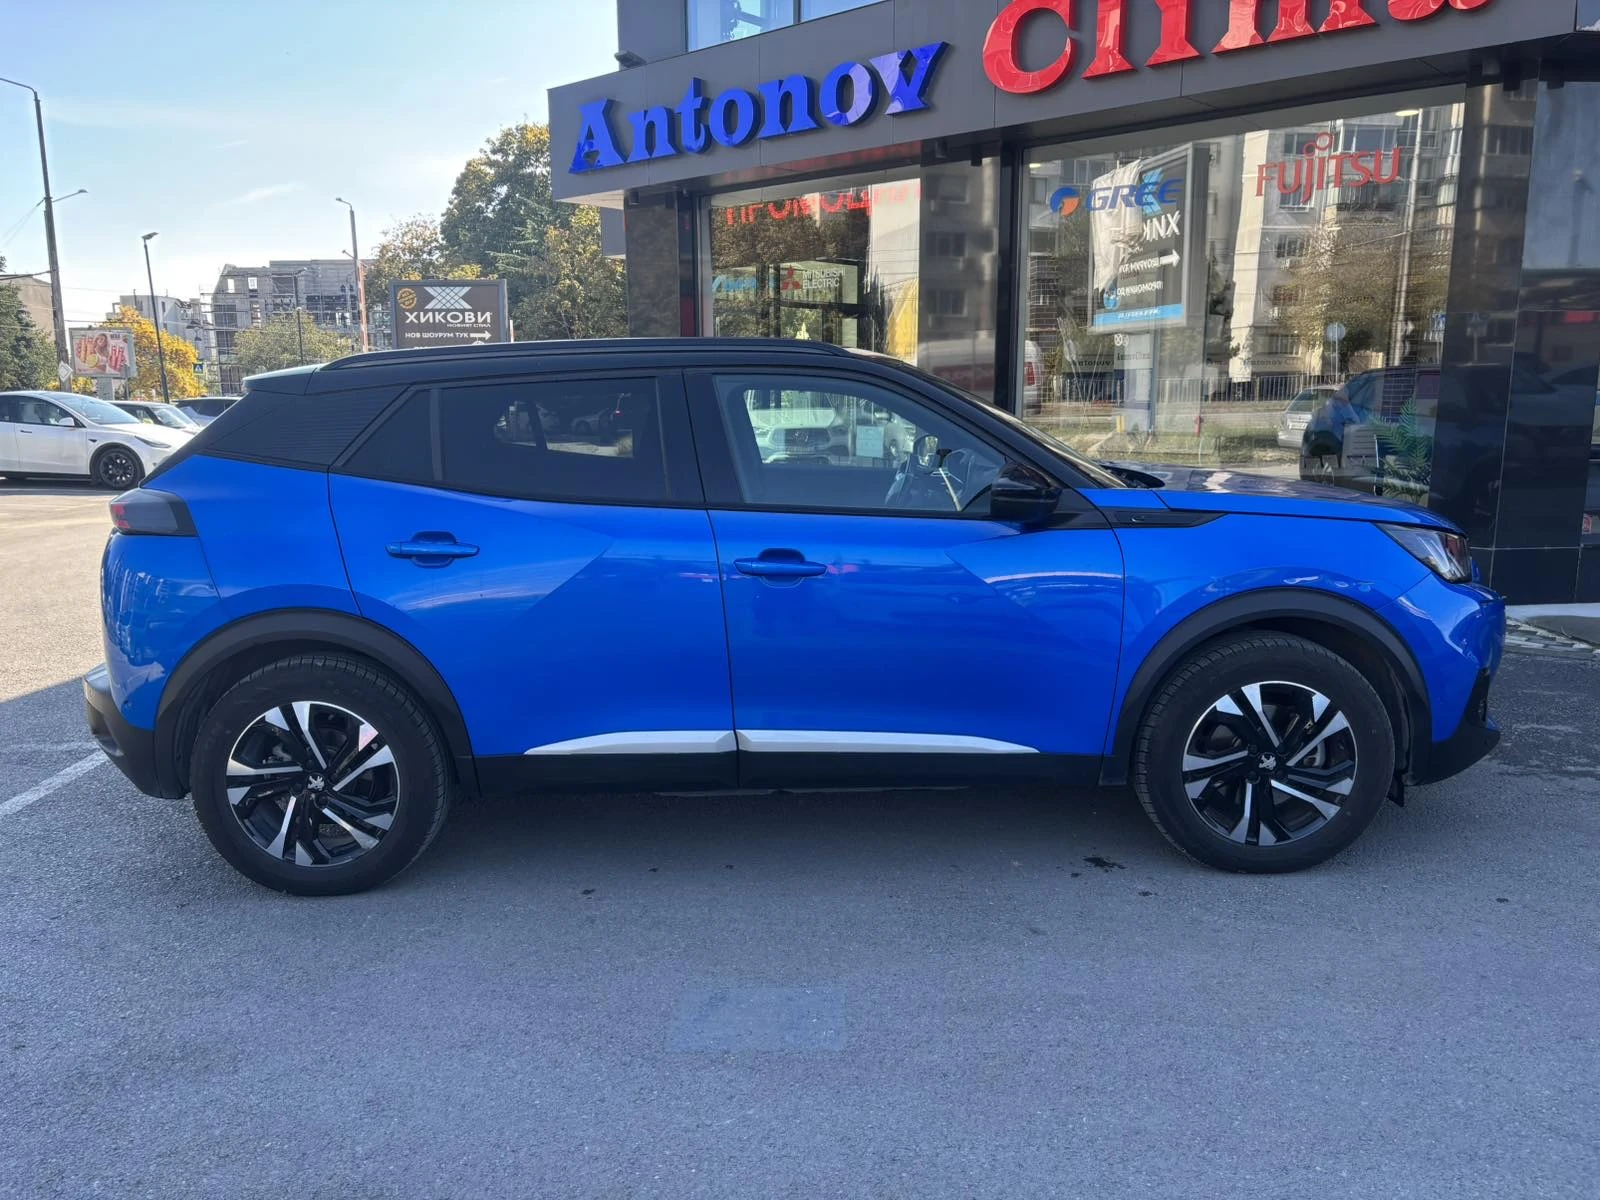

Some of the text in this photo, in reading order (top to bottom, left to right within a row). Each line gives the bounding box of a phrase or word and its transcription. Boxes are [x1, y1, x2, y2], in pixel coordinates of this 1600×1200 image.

[568, 41, 949, 174] Antonov
[1086, 179, 1184, 212] GREE
[803, 268, 845, 279] MITSUBISHI
[803, 277, 840, 289] ELECTRIC
[405, 312, 491, 323] ХИКОВИ
